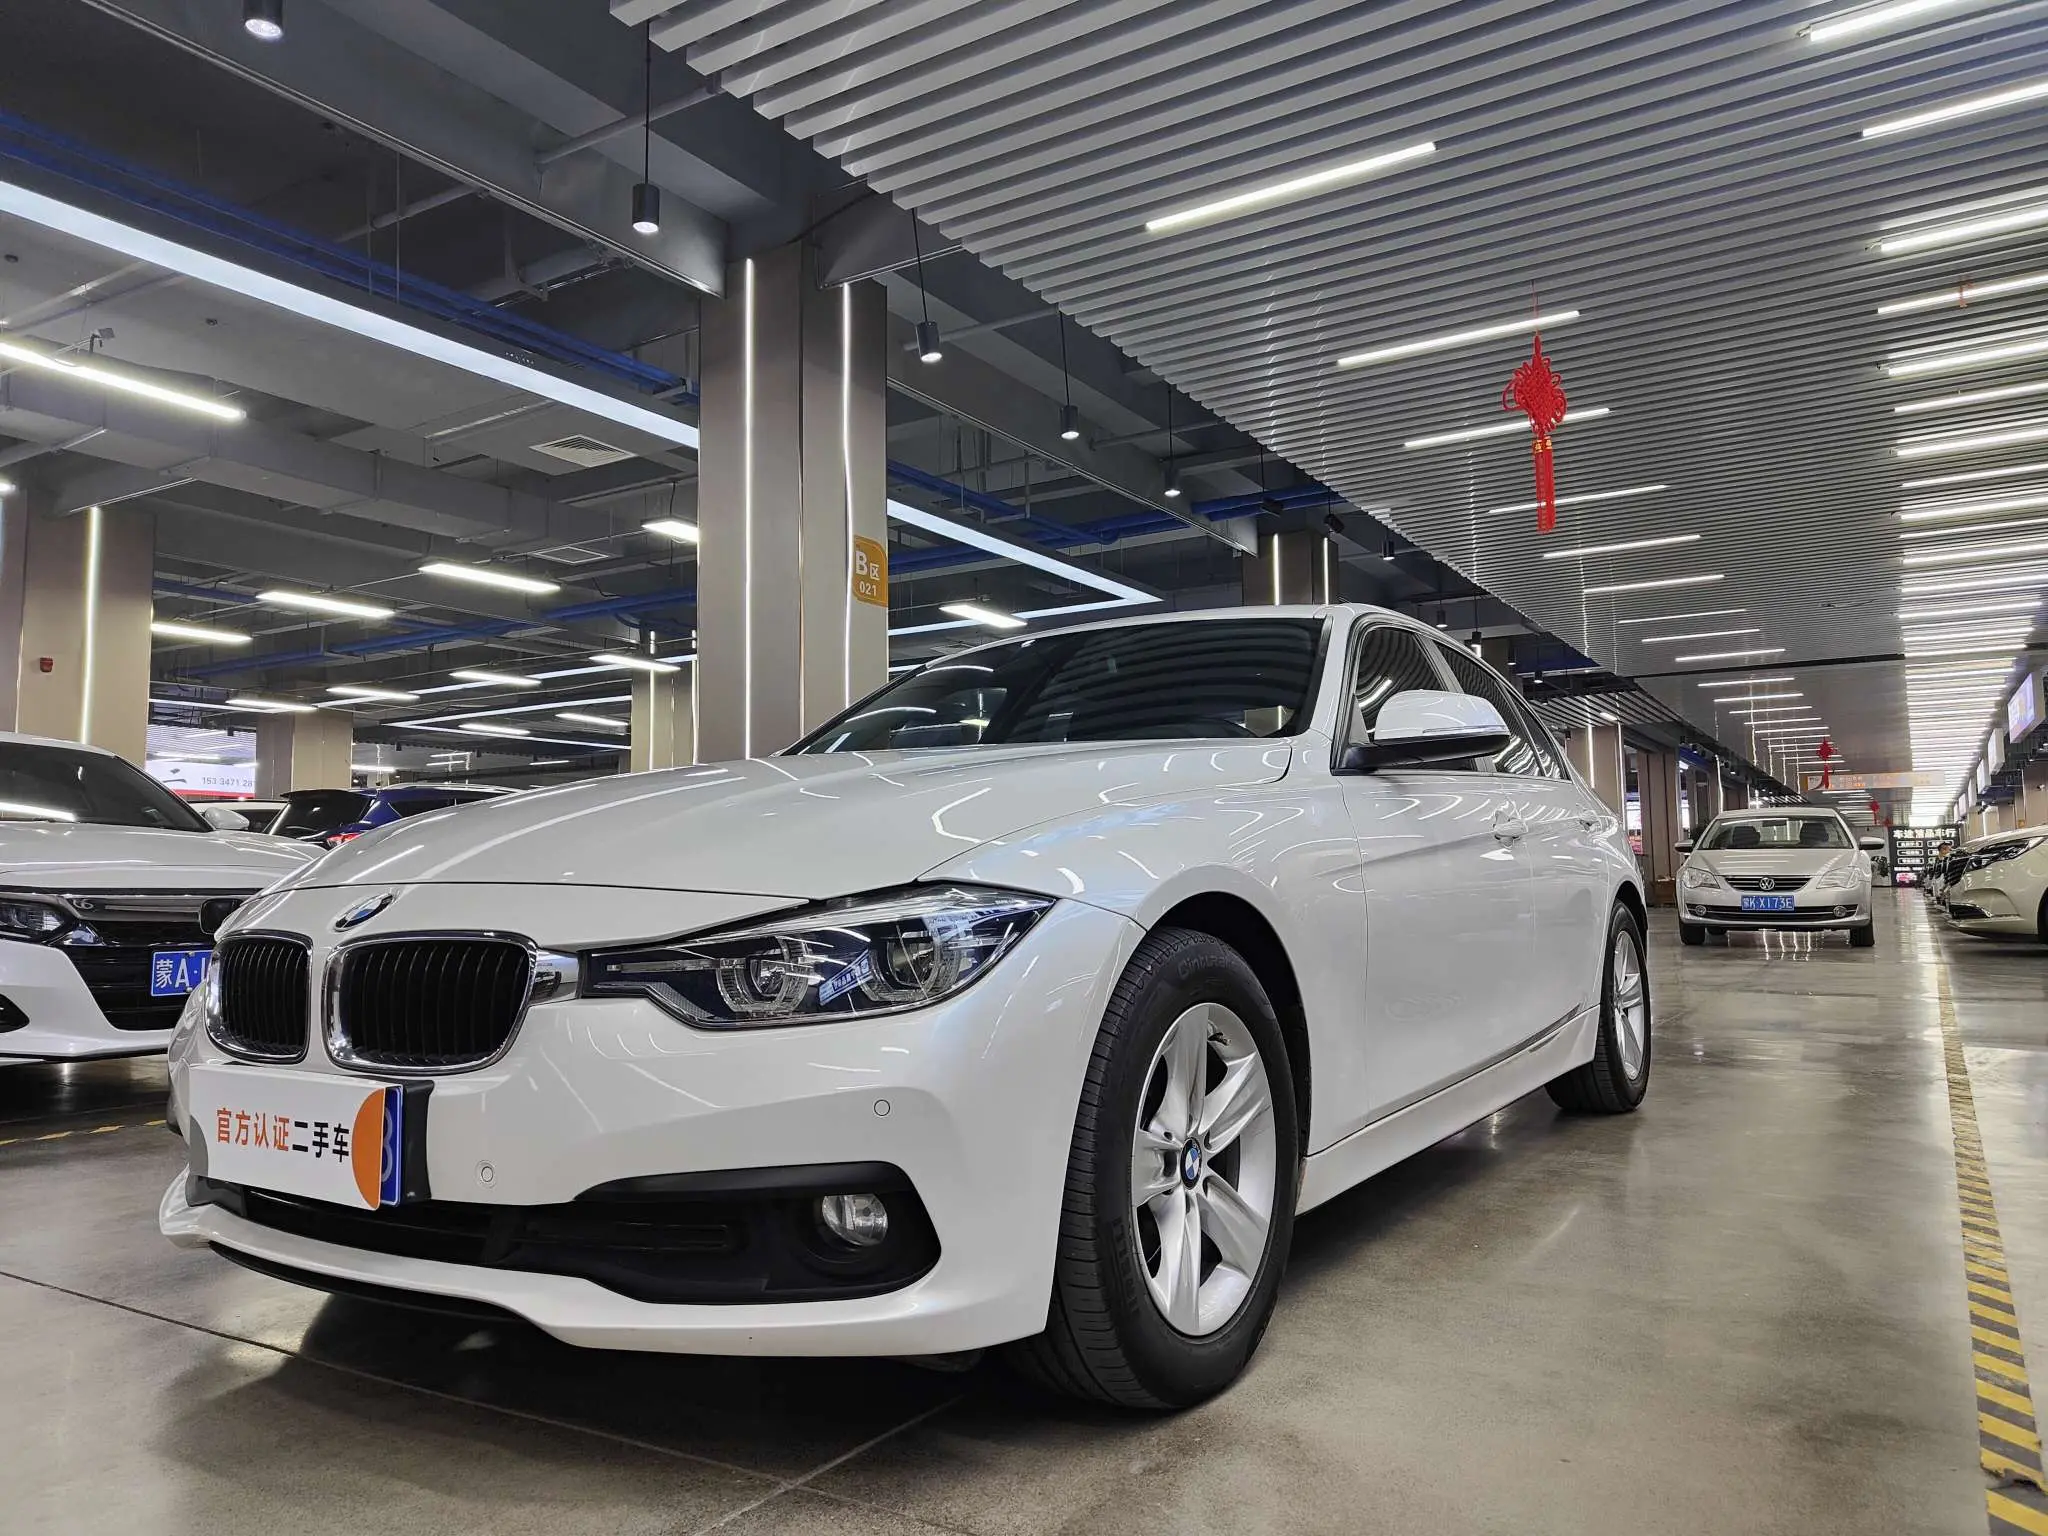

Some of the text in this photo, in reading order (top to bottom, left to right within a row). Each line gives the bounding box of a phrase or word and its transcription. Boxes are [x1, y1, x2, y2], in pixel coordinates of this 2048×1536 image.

[855, 551, 880, 580] B区
[860, 581, 877, 597] 021
[216, 1107, 350, 1163] 官方认证二手车
